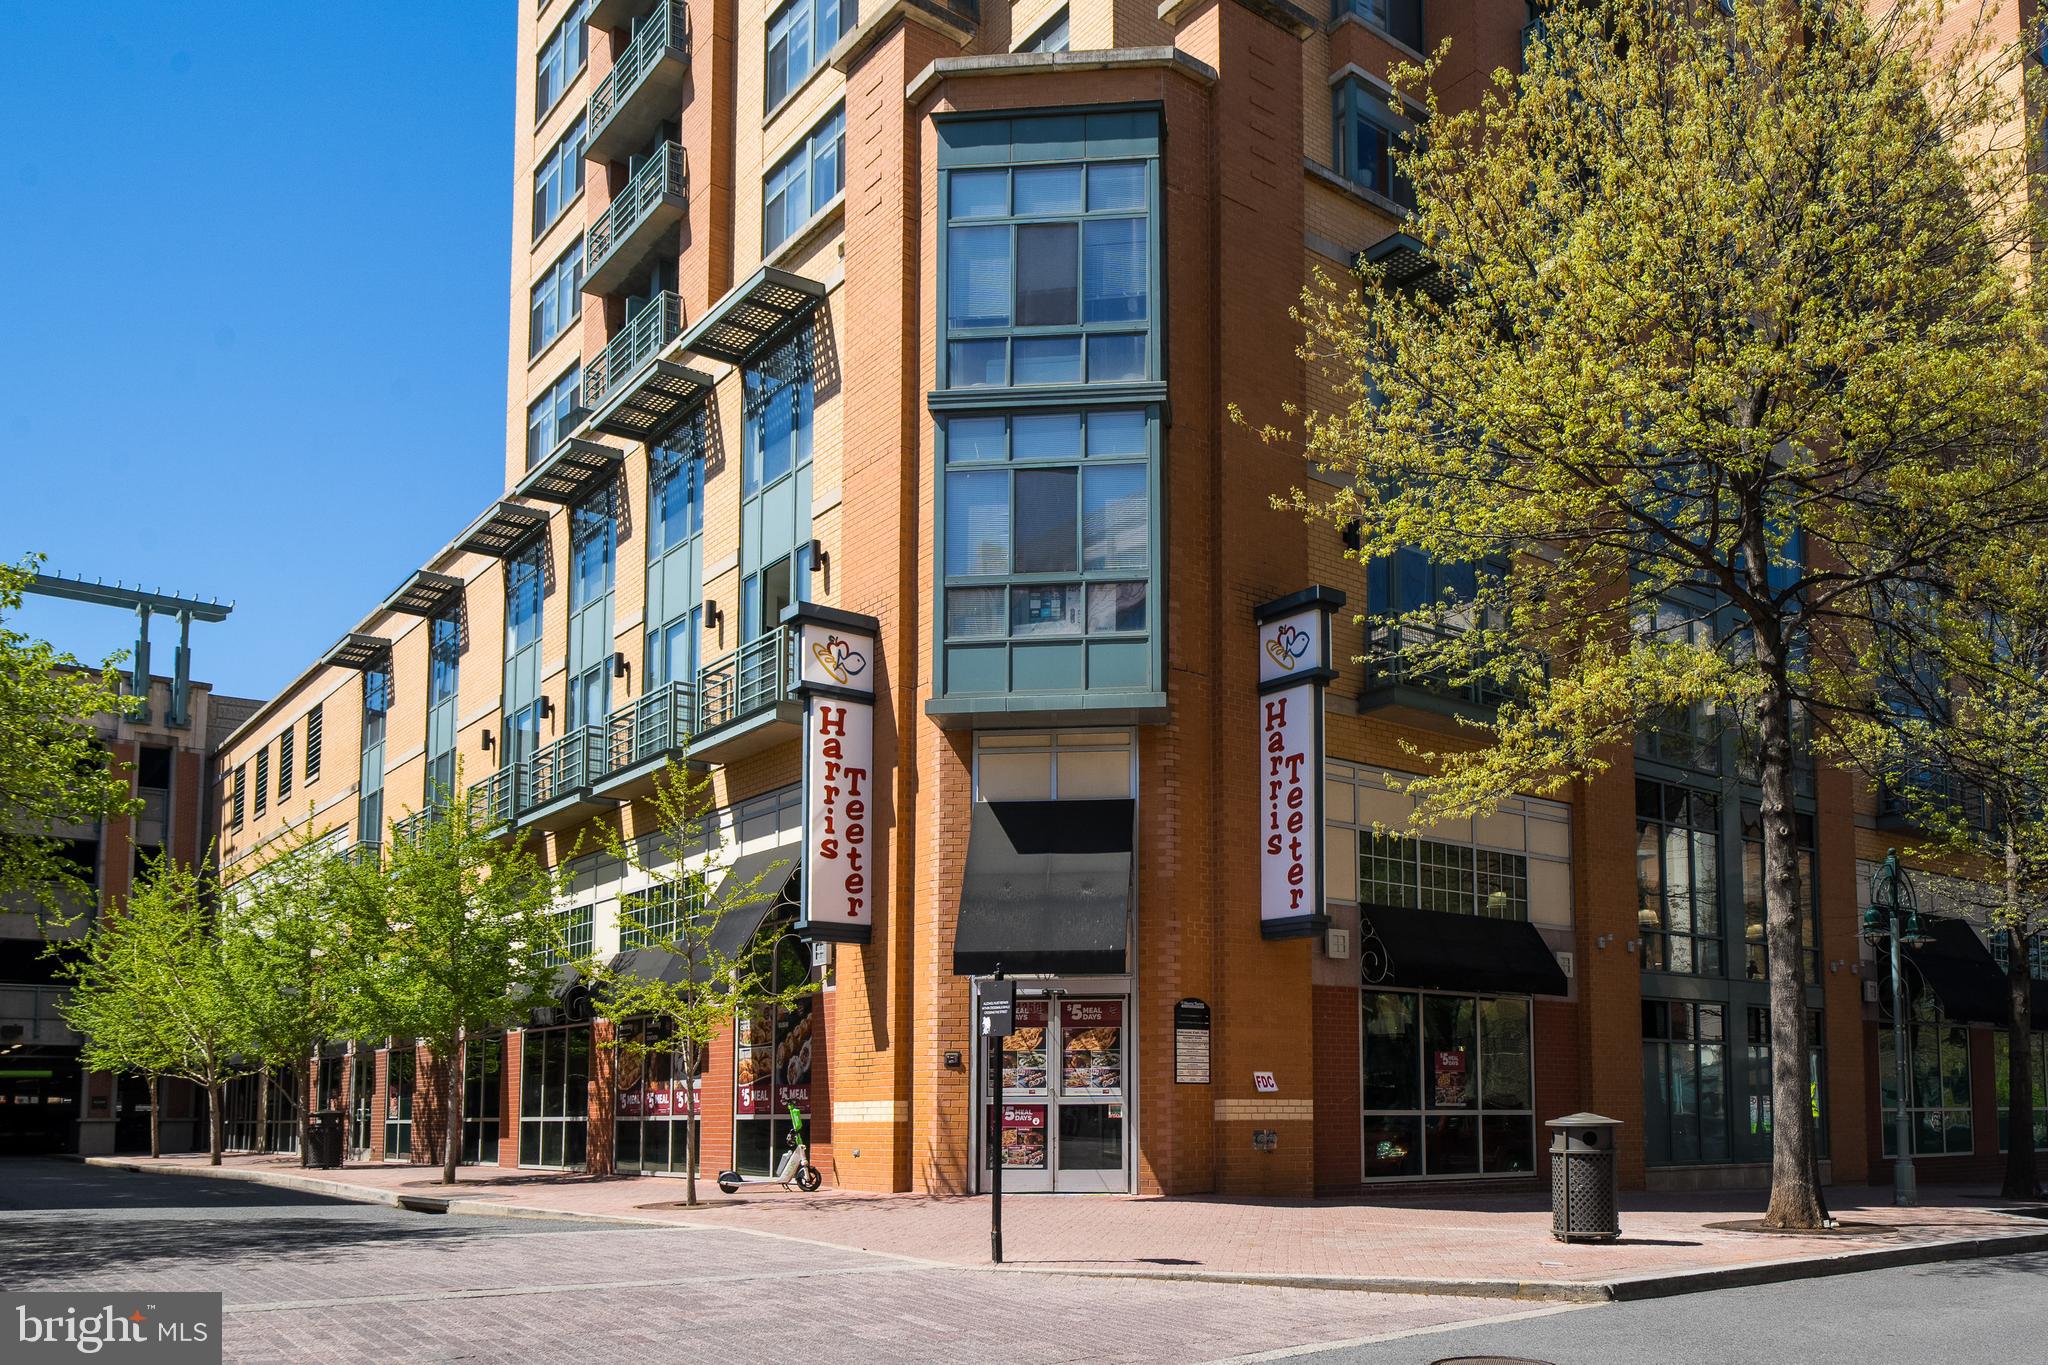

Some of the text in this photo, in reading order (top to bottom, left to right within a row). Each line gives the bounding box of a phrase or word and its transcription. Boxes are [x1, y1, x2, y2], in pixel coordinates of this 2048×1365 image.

[819, 706, 846, 860] Harris
[1266, 697, 1287, 856] Harris
[1285, 753, 1304, 910] Teeter
[844, 767, 866, 917] Teeter
[1066, 1003, 1082, 1020] $5
[1082, 1013, 1102, 1021] DAYS
[1255, 1075, 1275, 1088] FDC
[626, 1094, 641, 1105] MEAL
[646, 1092, 670, 1109] $5 MEAL
[676, 1091, 684, 1108] $5
[741, 1088, 769, 1107] $5 MEAL
[789, 1088, 809, 1100] MEAL
